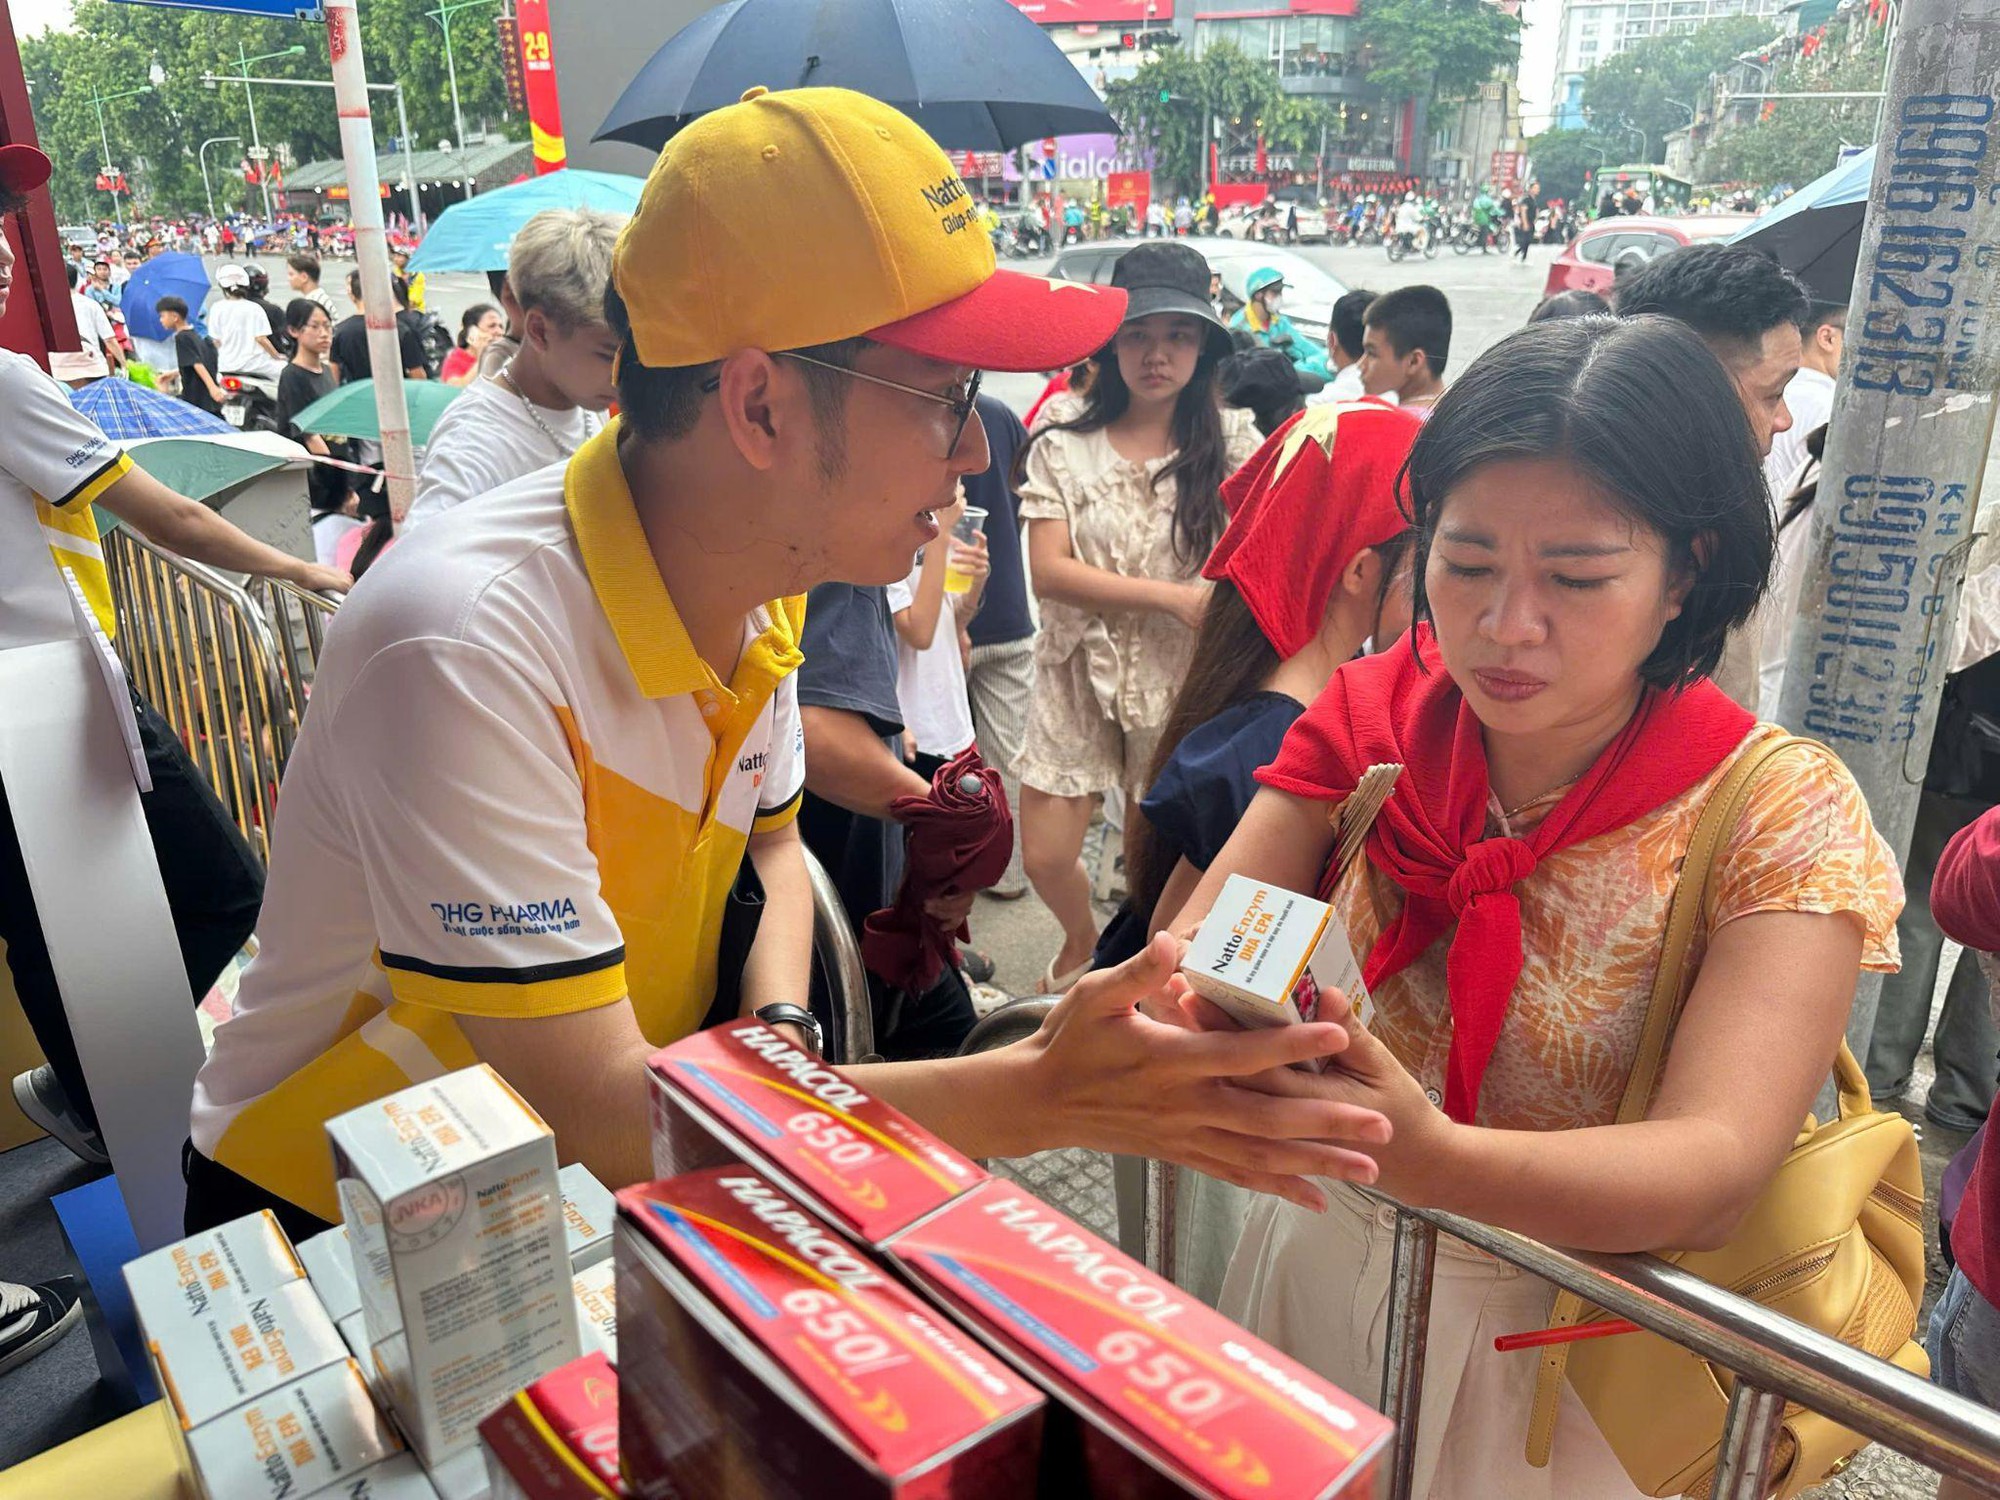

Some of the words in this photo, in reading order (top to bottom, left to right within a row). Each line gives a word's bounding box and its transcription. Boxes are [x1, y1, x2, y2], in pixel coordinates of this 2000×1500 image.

[1853, 94, 1994, 396] 0916162313
[65, 449, 86, 466] DHG
[431, 903, 483, 923] DHG
[489, 897, 577, 923] PHARMA
[1212, 889, 1268, 974] NattoEnzym
[1238, 937, 1261, 962] DHA
[1253, 912, 1275, 936] EPA
[730, 1024, 869, 1113] HAPACOL
[787, 1111, 875, 1165] 650
[198, 1249, 219, 1271] EPA
[717, 1177, 886, 1294] HAPACOL
[982, 1197, 1185, 1330] HAPACOL
[171, 1245, 210, 1318] NattoEnzym
[229, 1323, 255, 1349] DHA
[239, 1347, 265, 1372] EPA
[248, 1297, 296, 1377] NattoEnzym
[781, 1288, 889, 1363] 650
[1096, 1329, 1223, 1413] 650
